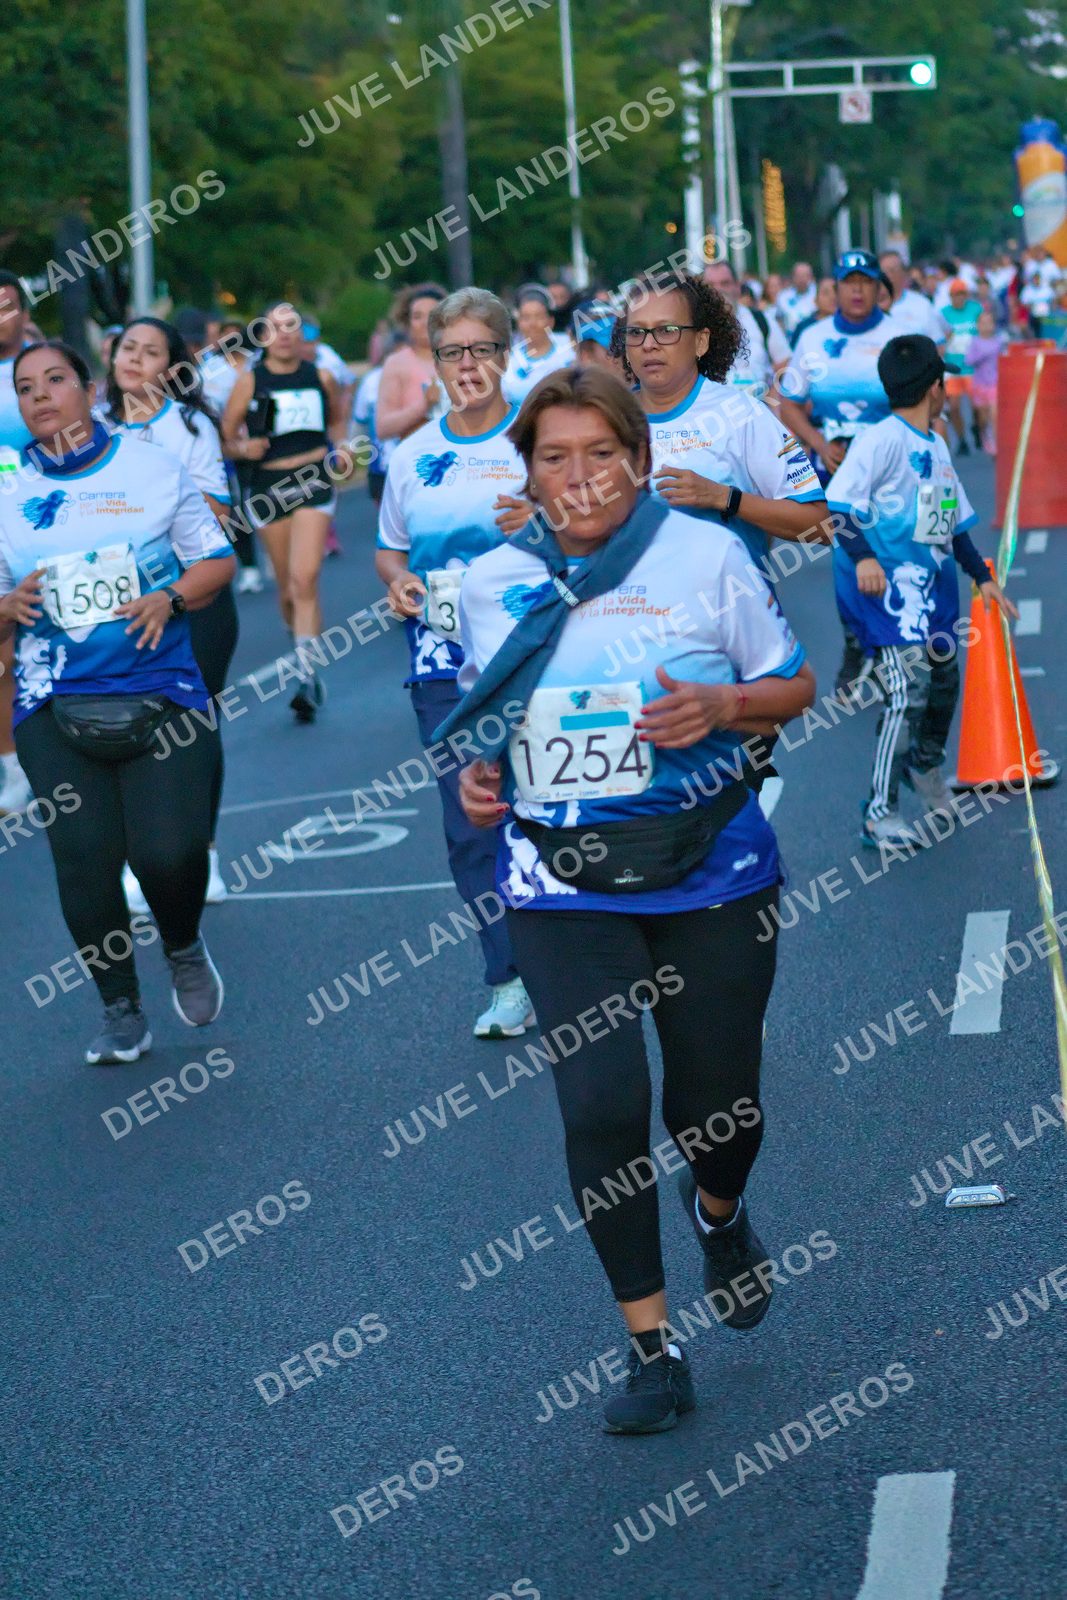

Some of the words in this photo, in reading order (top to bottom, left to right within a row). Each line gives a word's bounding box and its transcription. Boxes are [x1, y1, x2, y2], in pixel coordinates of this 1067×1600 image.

[79, 491, 126, 501] Carrera
[50, 576, 132, 618] 1508
[617, 595, 646, 605] Vida
[602, 605, 670, 616] Integridad
[518, 731, 648, 786] 1254
